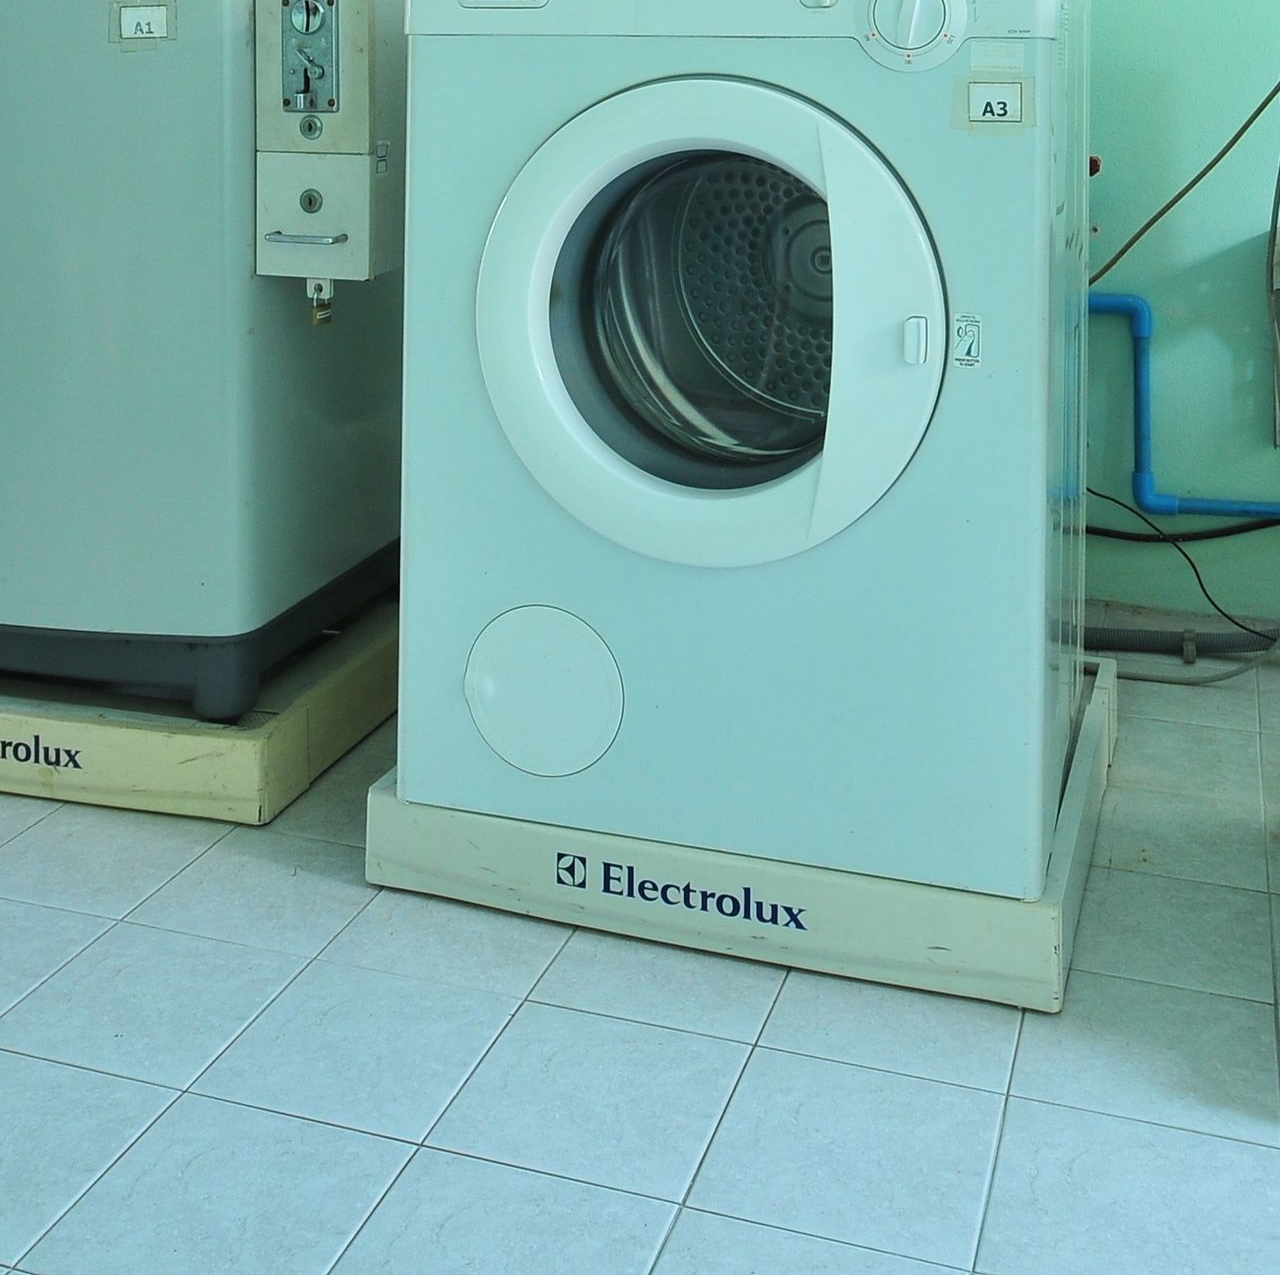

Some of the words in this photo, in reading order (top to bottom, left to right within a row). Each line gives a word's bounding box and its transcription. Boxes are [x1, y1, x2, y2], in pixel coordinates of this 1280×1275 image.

[134, 21, 154, 35] A1
[981, 101, 1009, 117] A3
[601, 861, 808, 931] Electrolux
